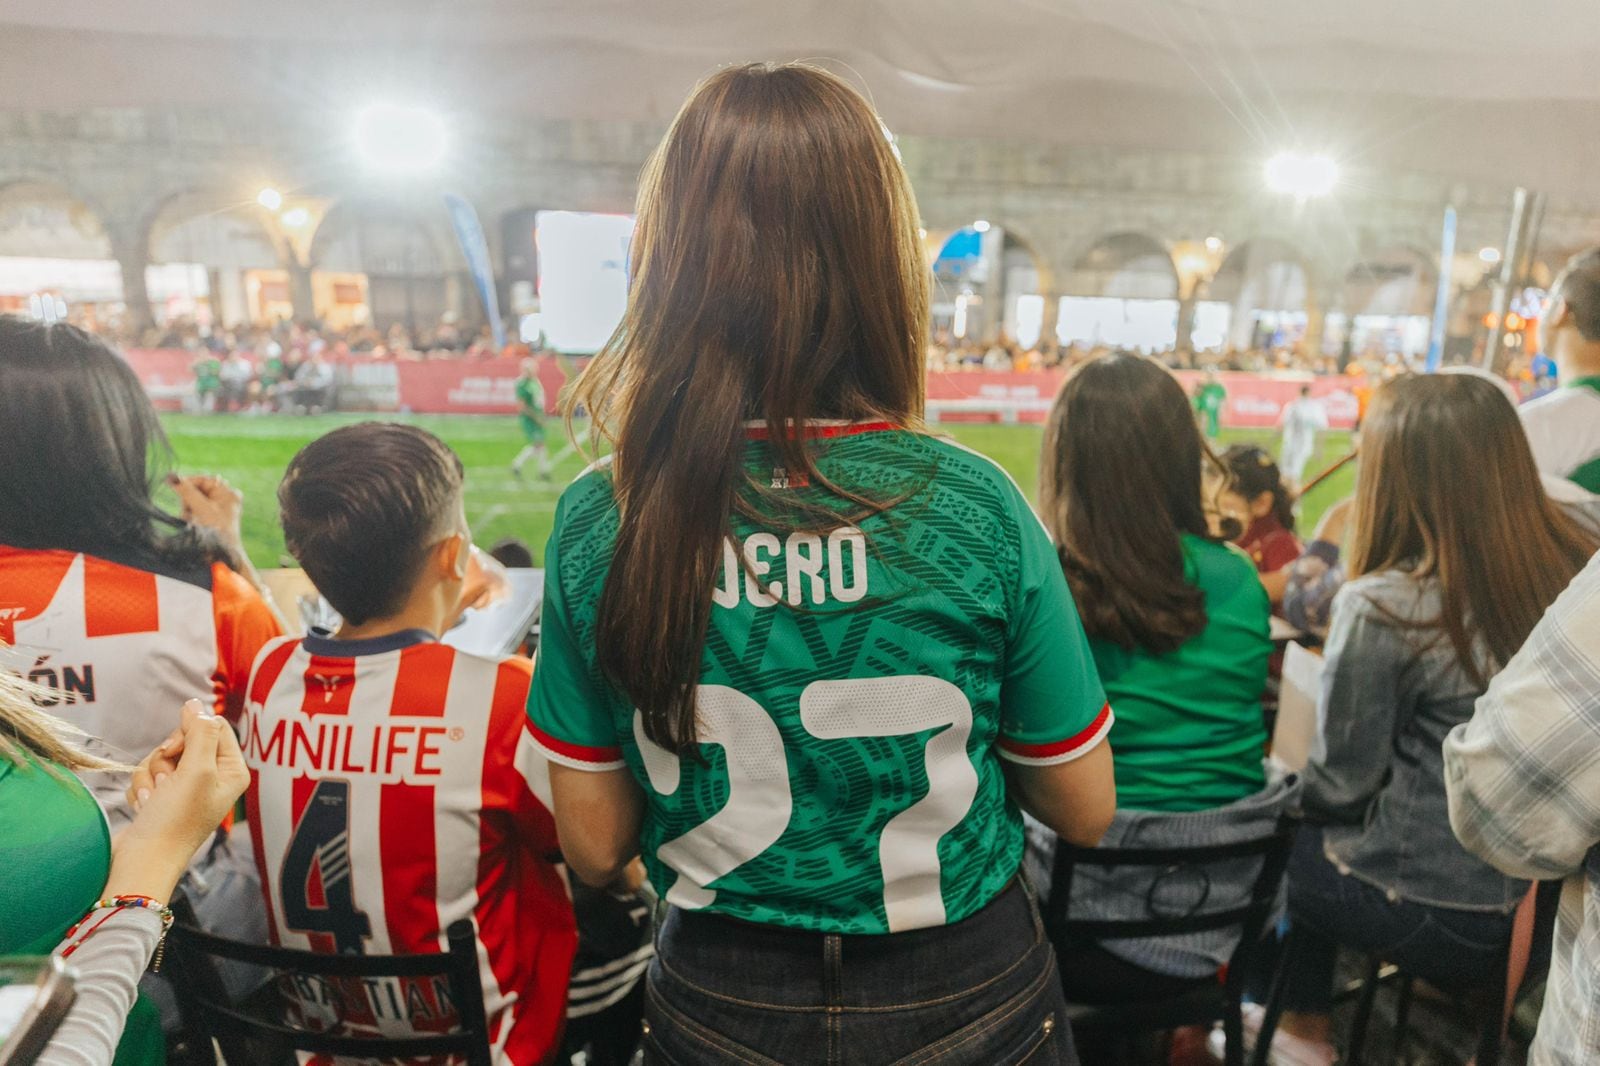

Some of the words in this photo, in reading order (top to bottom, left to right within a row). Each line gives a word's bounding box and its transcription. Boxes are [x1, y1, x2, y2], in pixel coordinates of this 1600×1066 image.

[10, 654, 96, 707] ÓN
[279, 777, 372, 955] 4
[633, 675, 979, 934] 27
